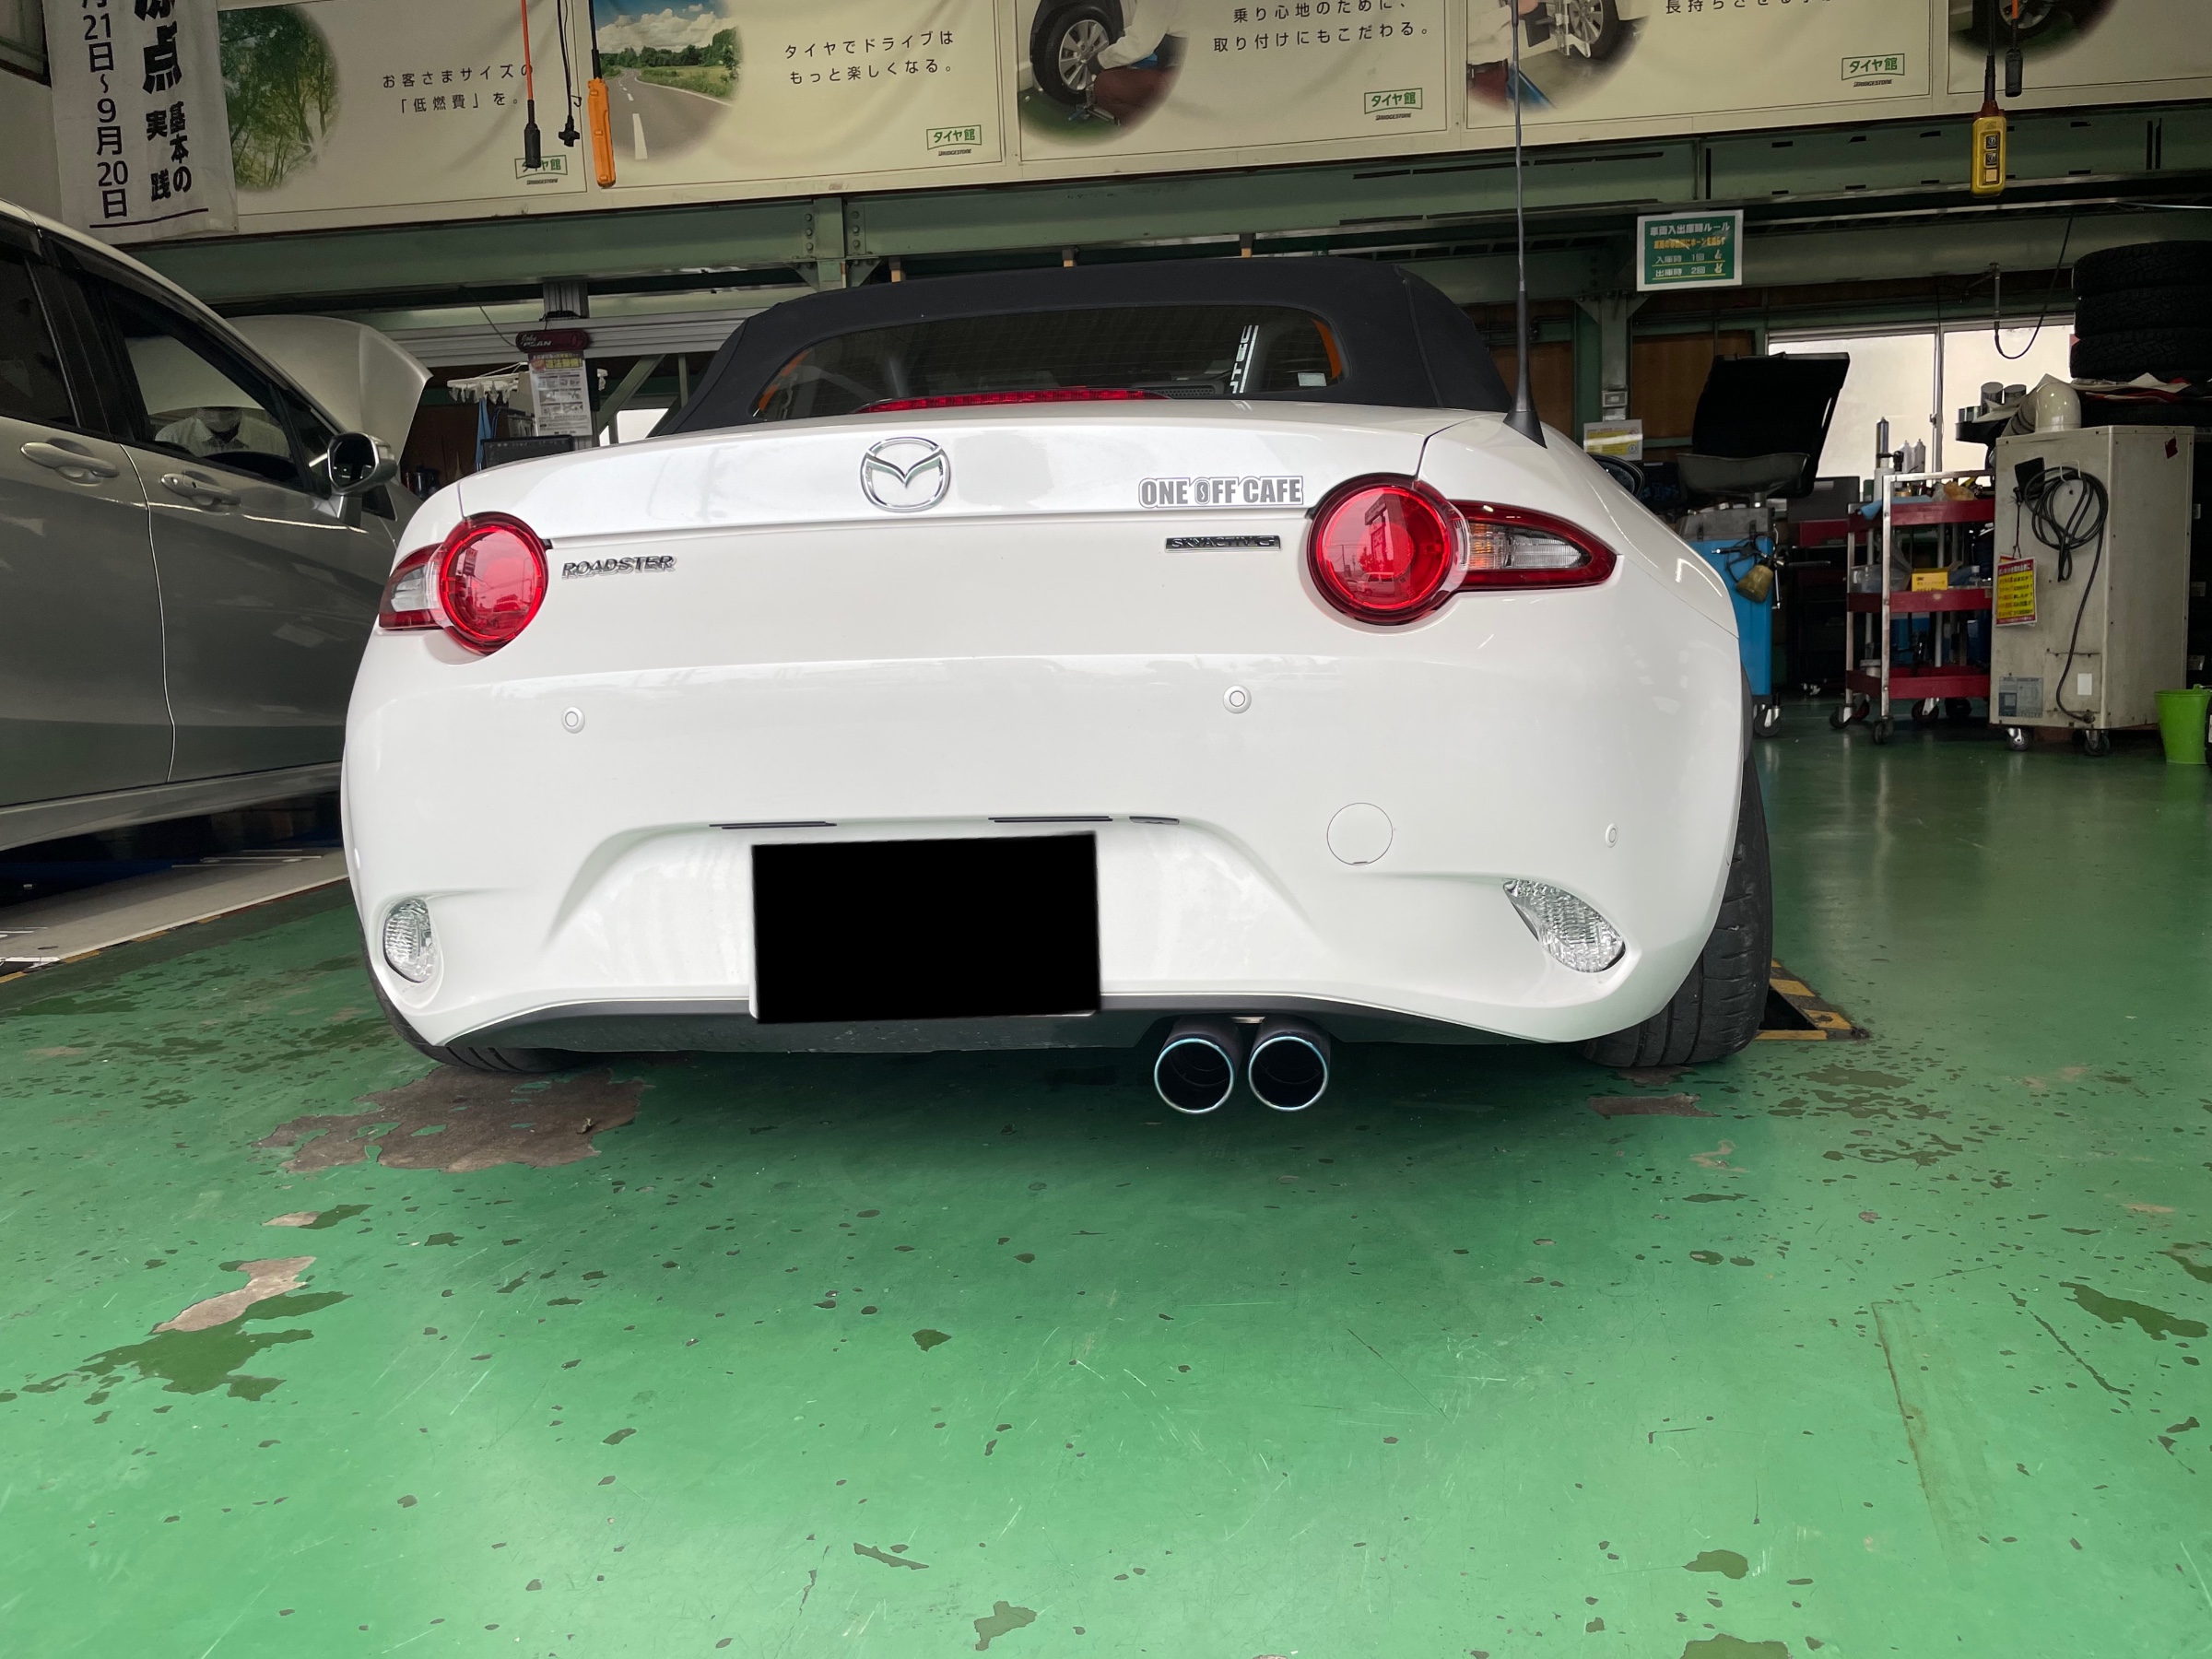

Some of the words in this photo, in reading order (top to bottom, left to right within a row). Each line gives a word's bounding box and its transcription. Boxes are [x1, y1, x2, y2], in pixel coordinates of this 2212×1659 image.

[785, 30, 954, 60] タイヤでドライブは
[1213, 21, 1428, 53] 取り付けにもこだわる。
[790, 59, 951, 85] もっと楽しくなる。
[1849, 57, 1898, 73] タイヤ館
[1371, 91, 1416, 107] タイヤ館
[934, 128, 975, 143] タイヤ館
[1141, 480, 1188, 505] ONE
[1195, 479, 1236, 504] OFF
[1243, 478, 1301, 503] CAFE
[561, 555, 676, 579] ROADSTER
